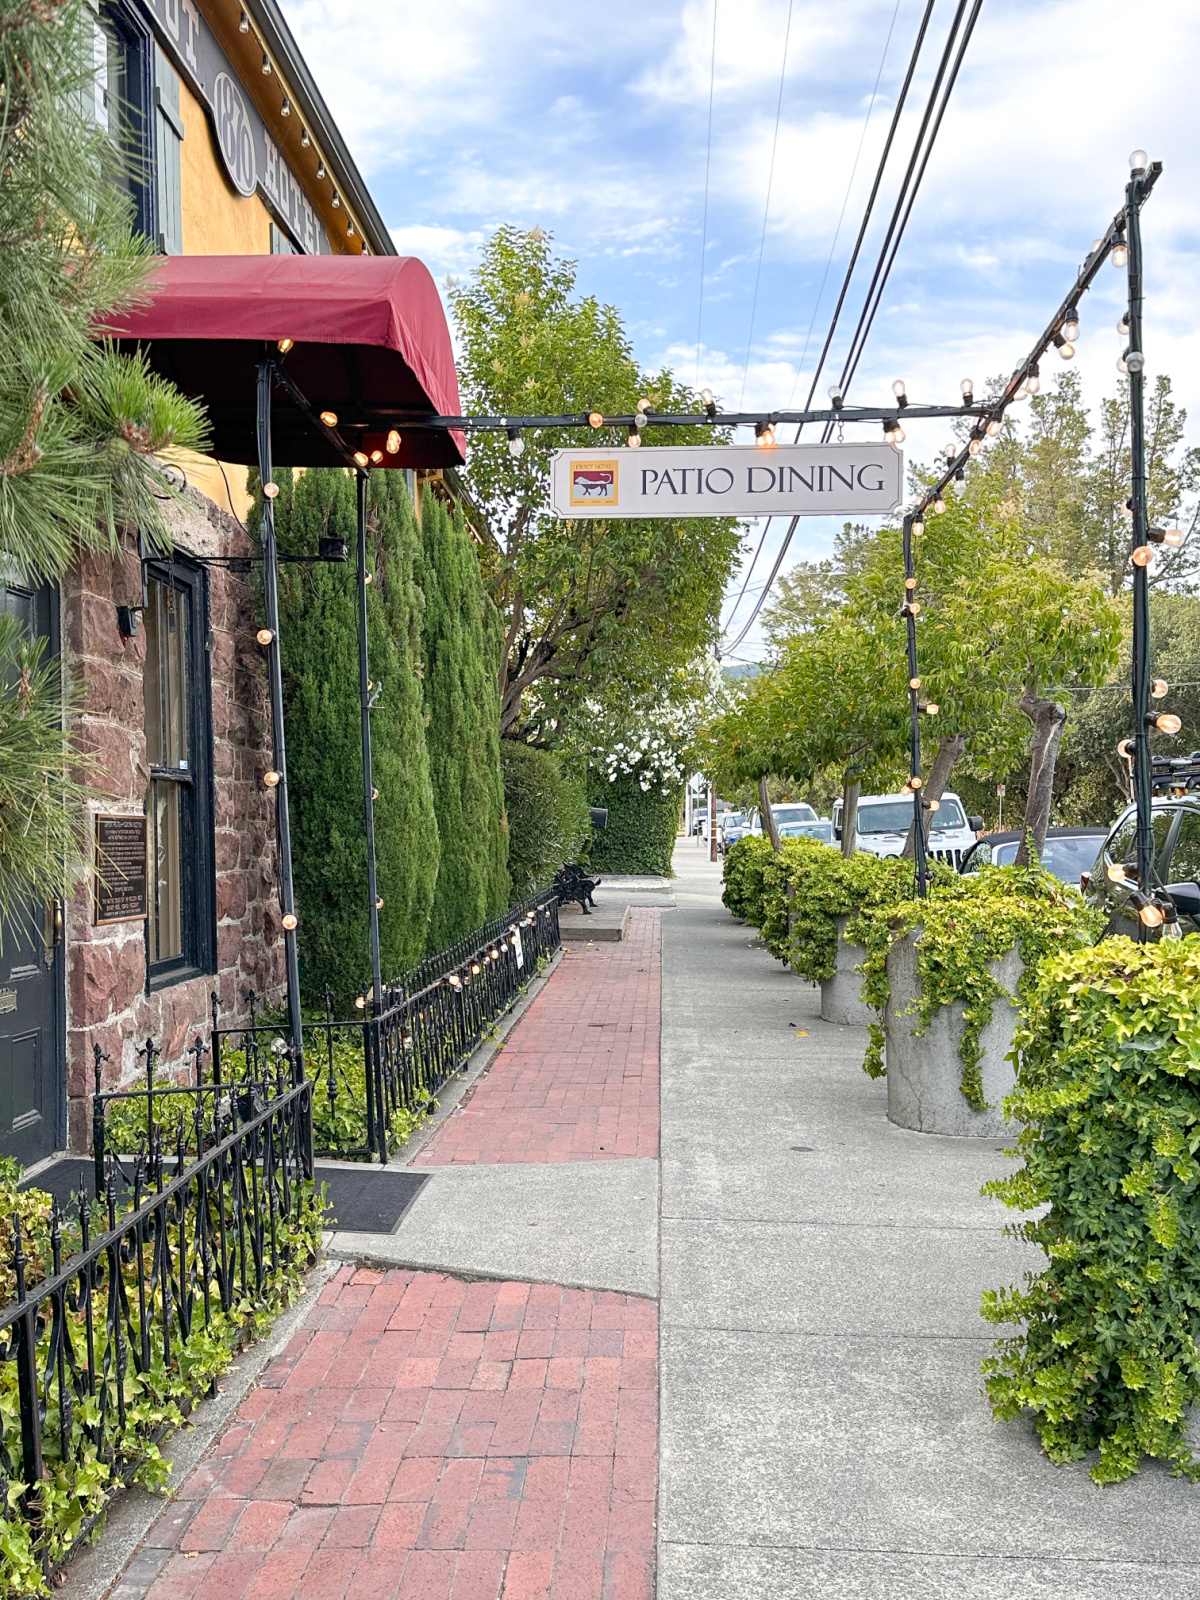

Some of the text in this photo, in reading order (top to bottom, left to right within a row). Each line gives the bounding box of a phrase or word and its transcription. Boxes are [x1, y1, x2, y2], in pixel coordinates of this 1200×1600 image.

[153, 0, 199, 74] OT
[216, 76, 253, 188] 1870
[640, 463, 885, 495] PATIO DINING
